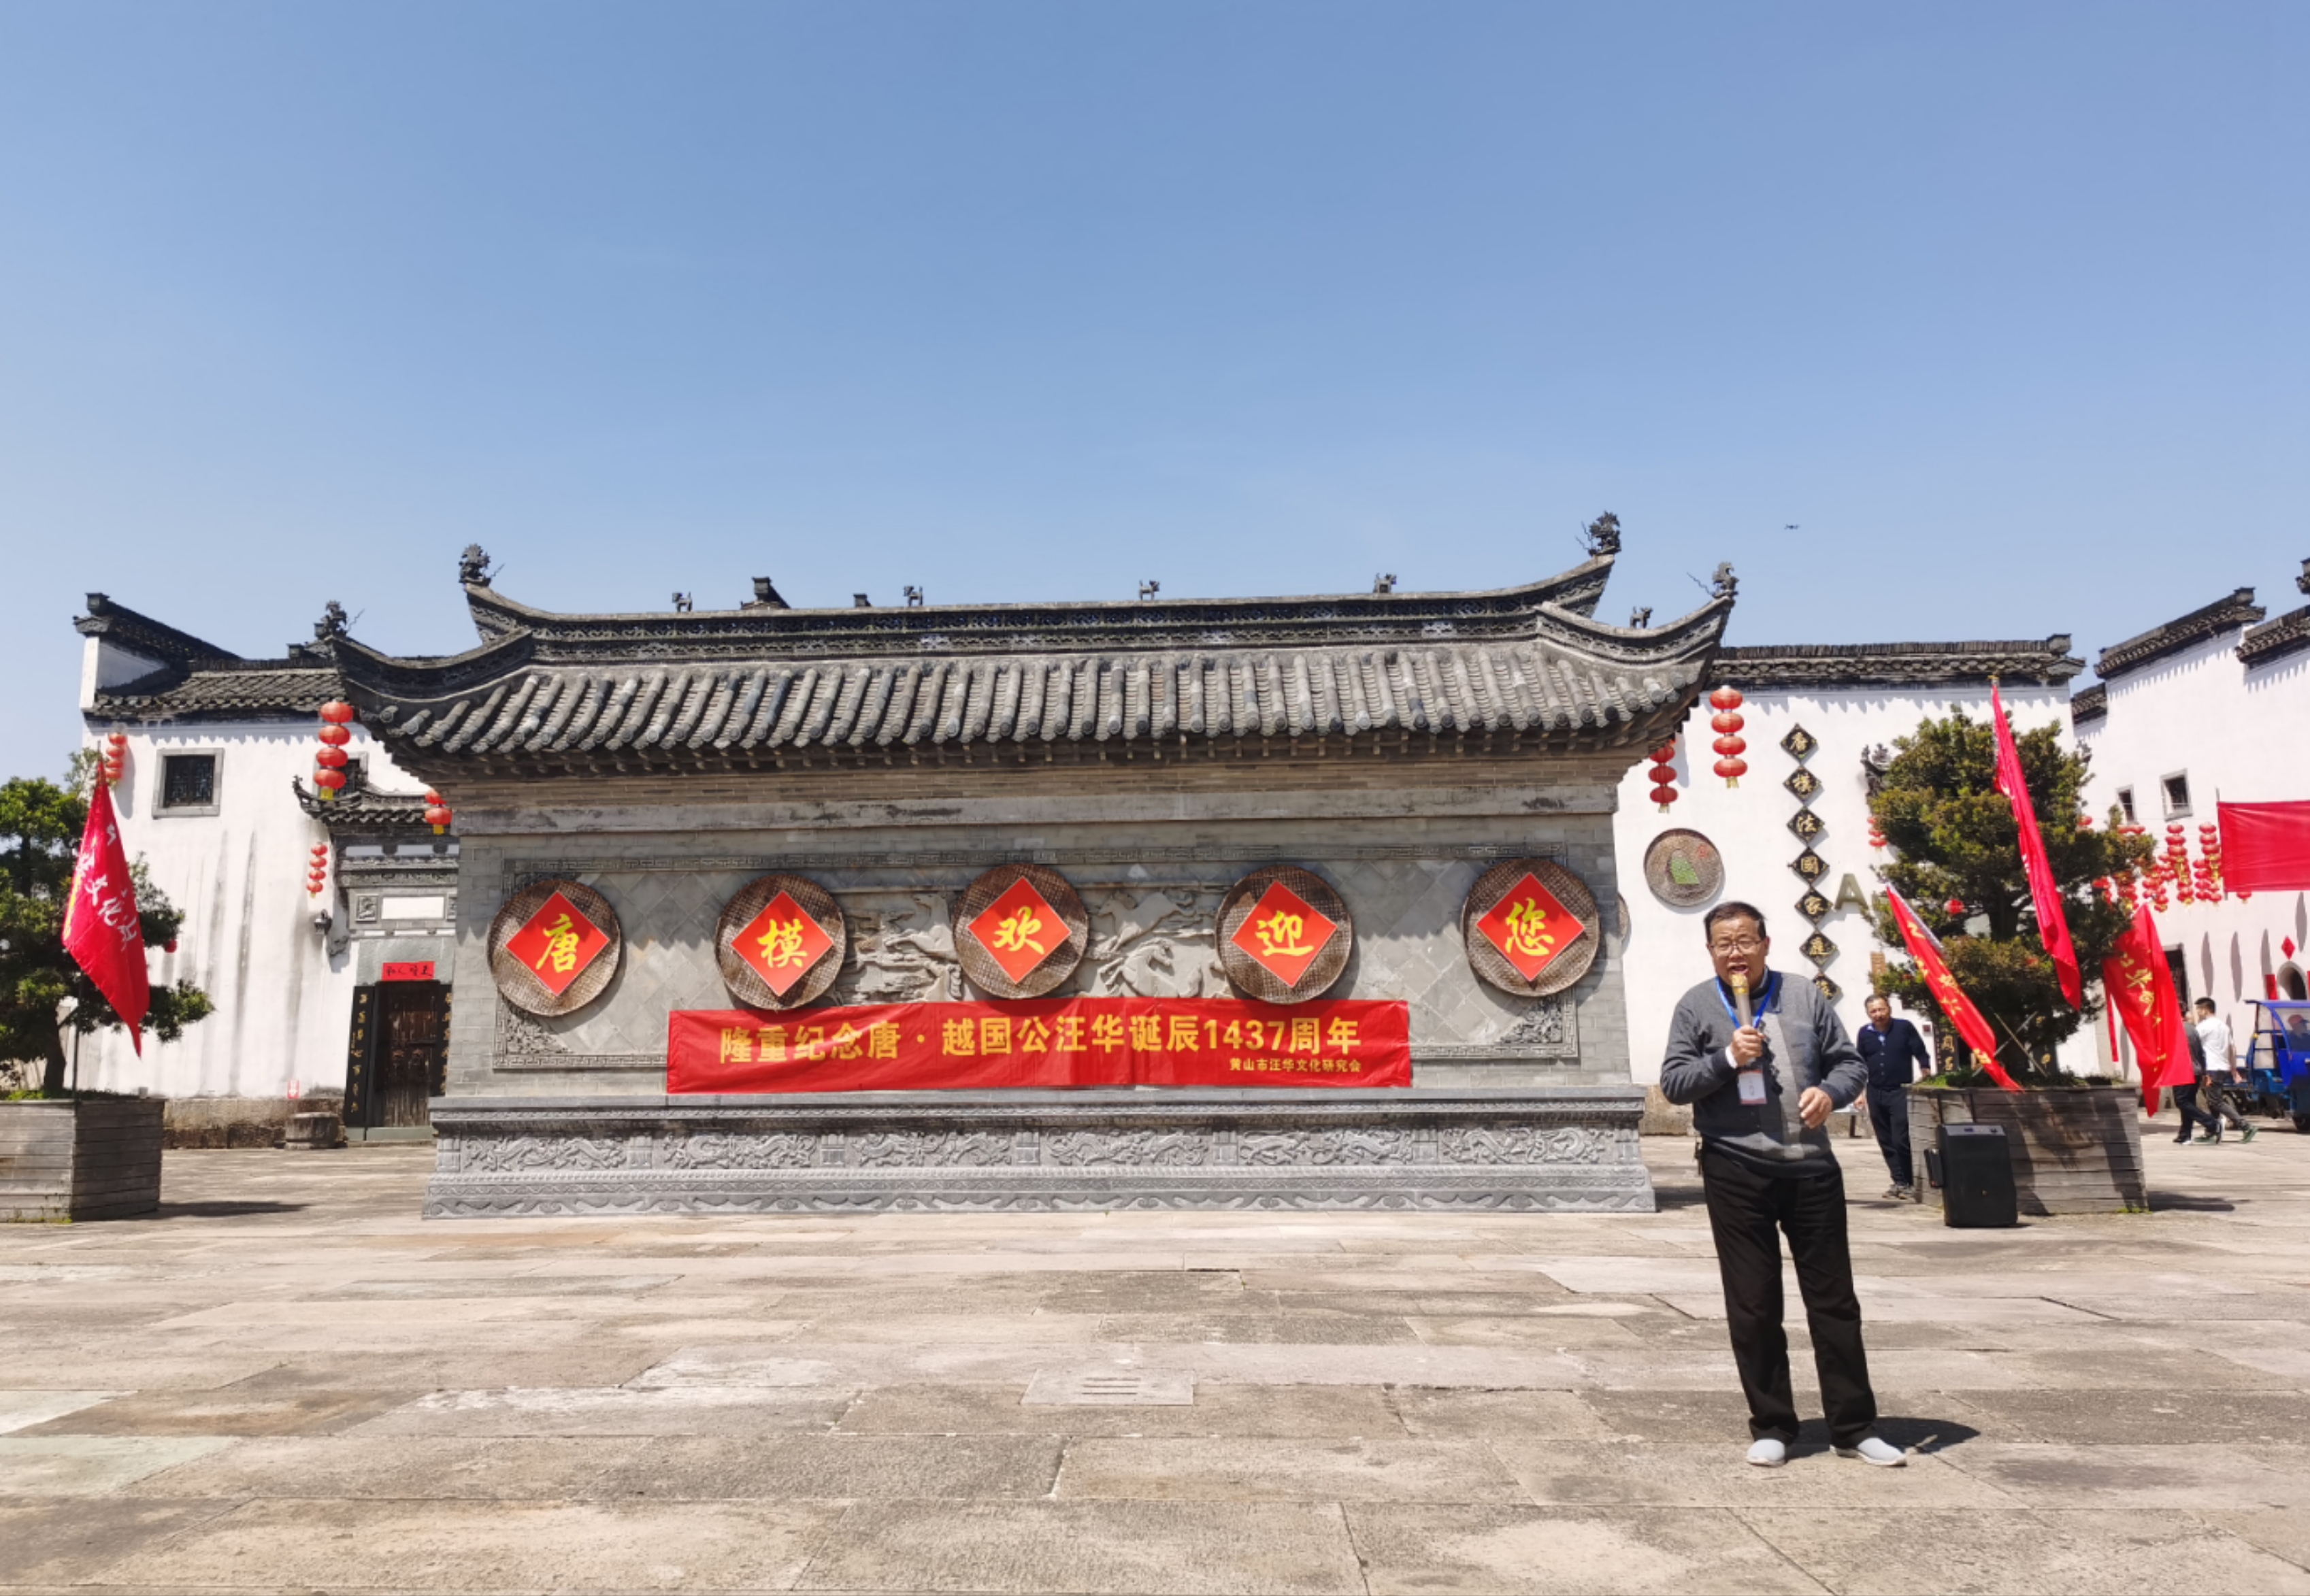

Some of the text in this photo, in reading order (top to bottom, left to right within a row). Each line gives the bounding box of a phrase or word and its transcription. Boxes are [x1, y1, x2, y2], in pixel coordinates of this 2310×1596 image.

[535, 897, 1555, 974] 唐 模 欢 迎 您
[1230, 1058, 1361, 1072] 黄山市汪华文化研究会
